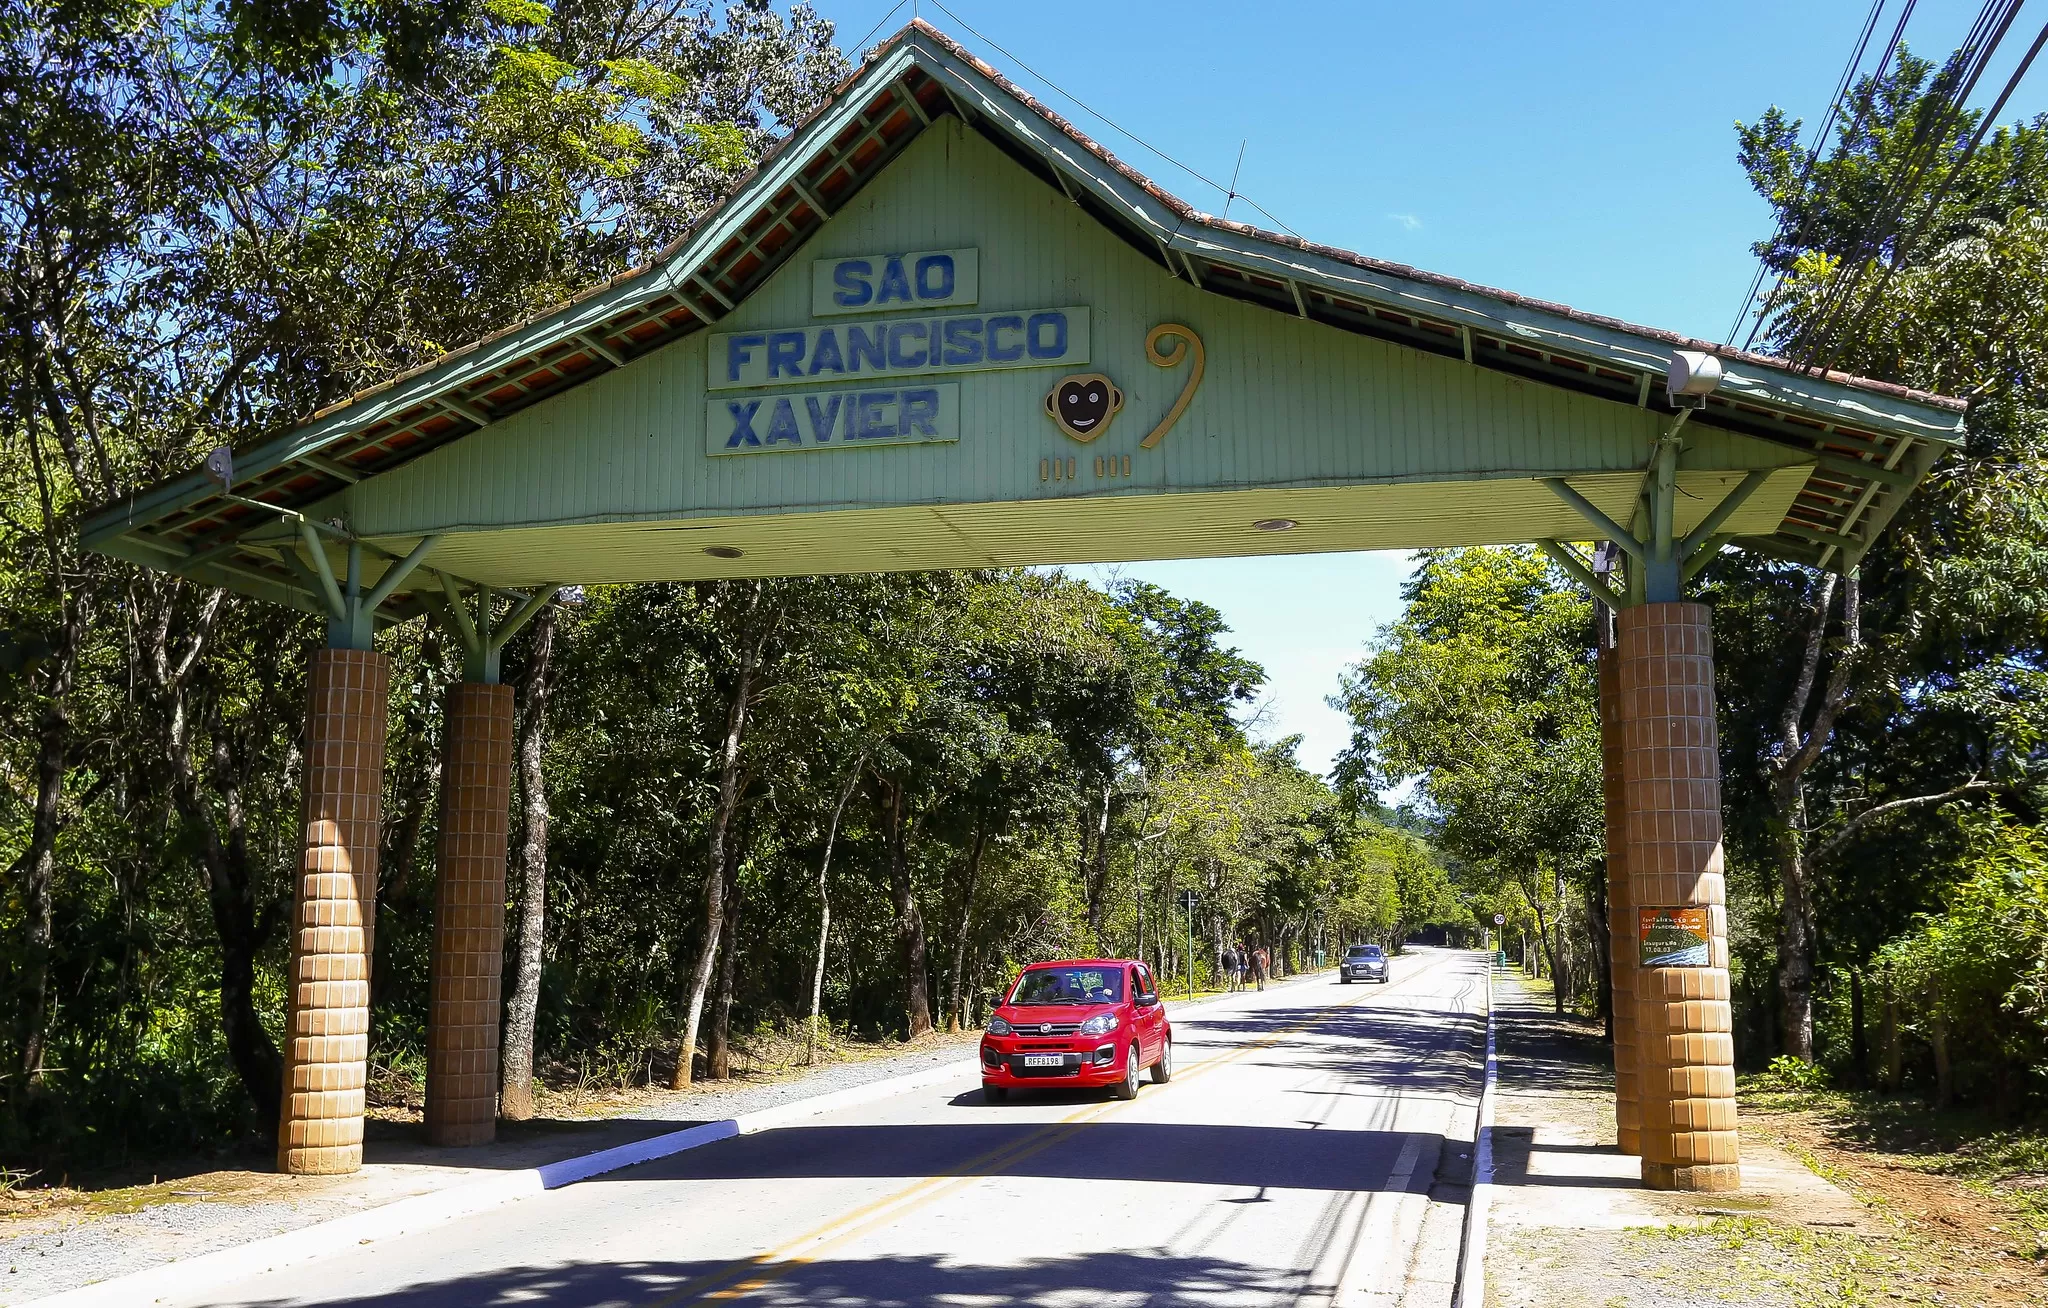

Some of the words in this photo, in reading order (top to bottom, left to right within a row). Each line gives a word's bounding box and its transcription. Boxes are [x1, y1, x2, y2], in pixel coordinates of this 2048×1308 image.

[833, 254, 955, 307] SÃO
[727, 312, 1068, 382] FRANCISCO
[725, 388, 940, 448] XAVIER
